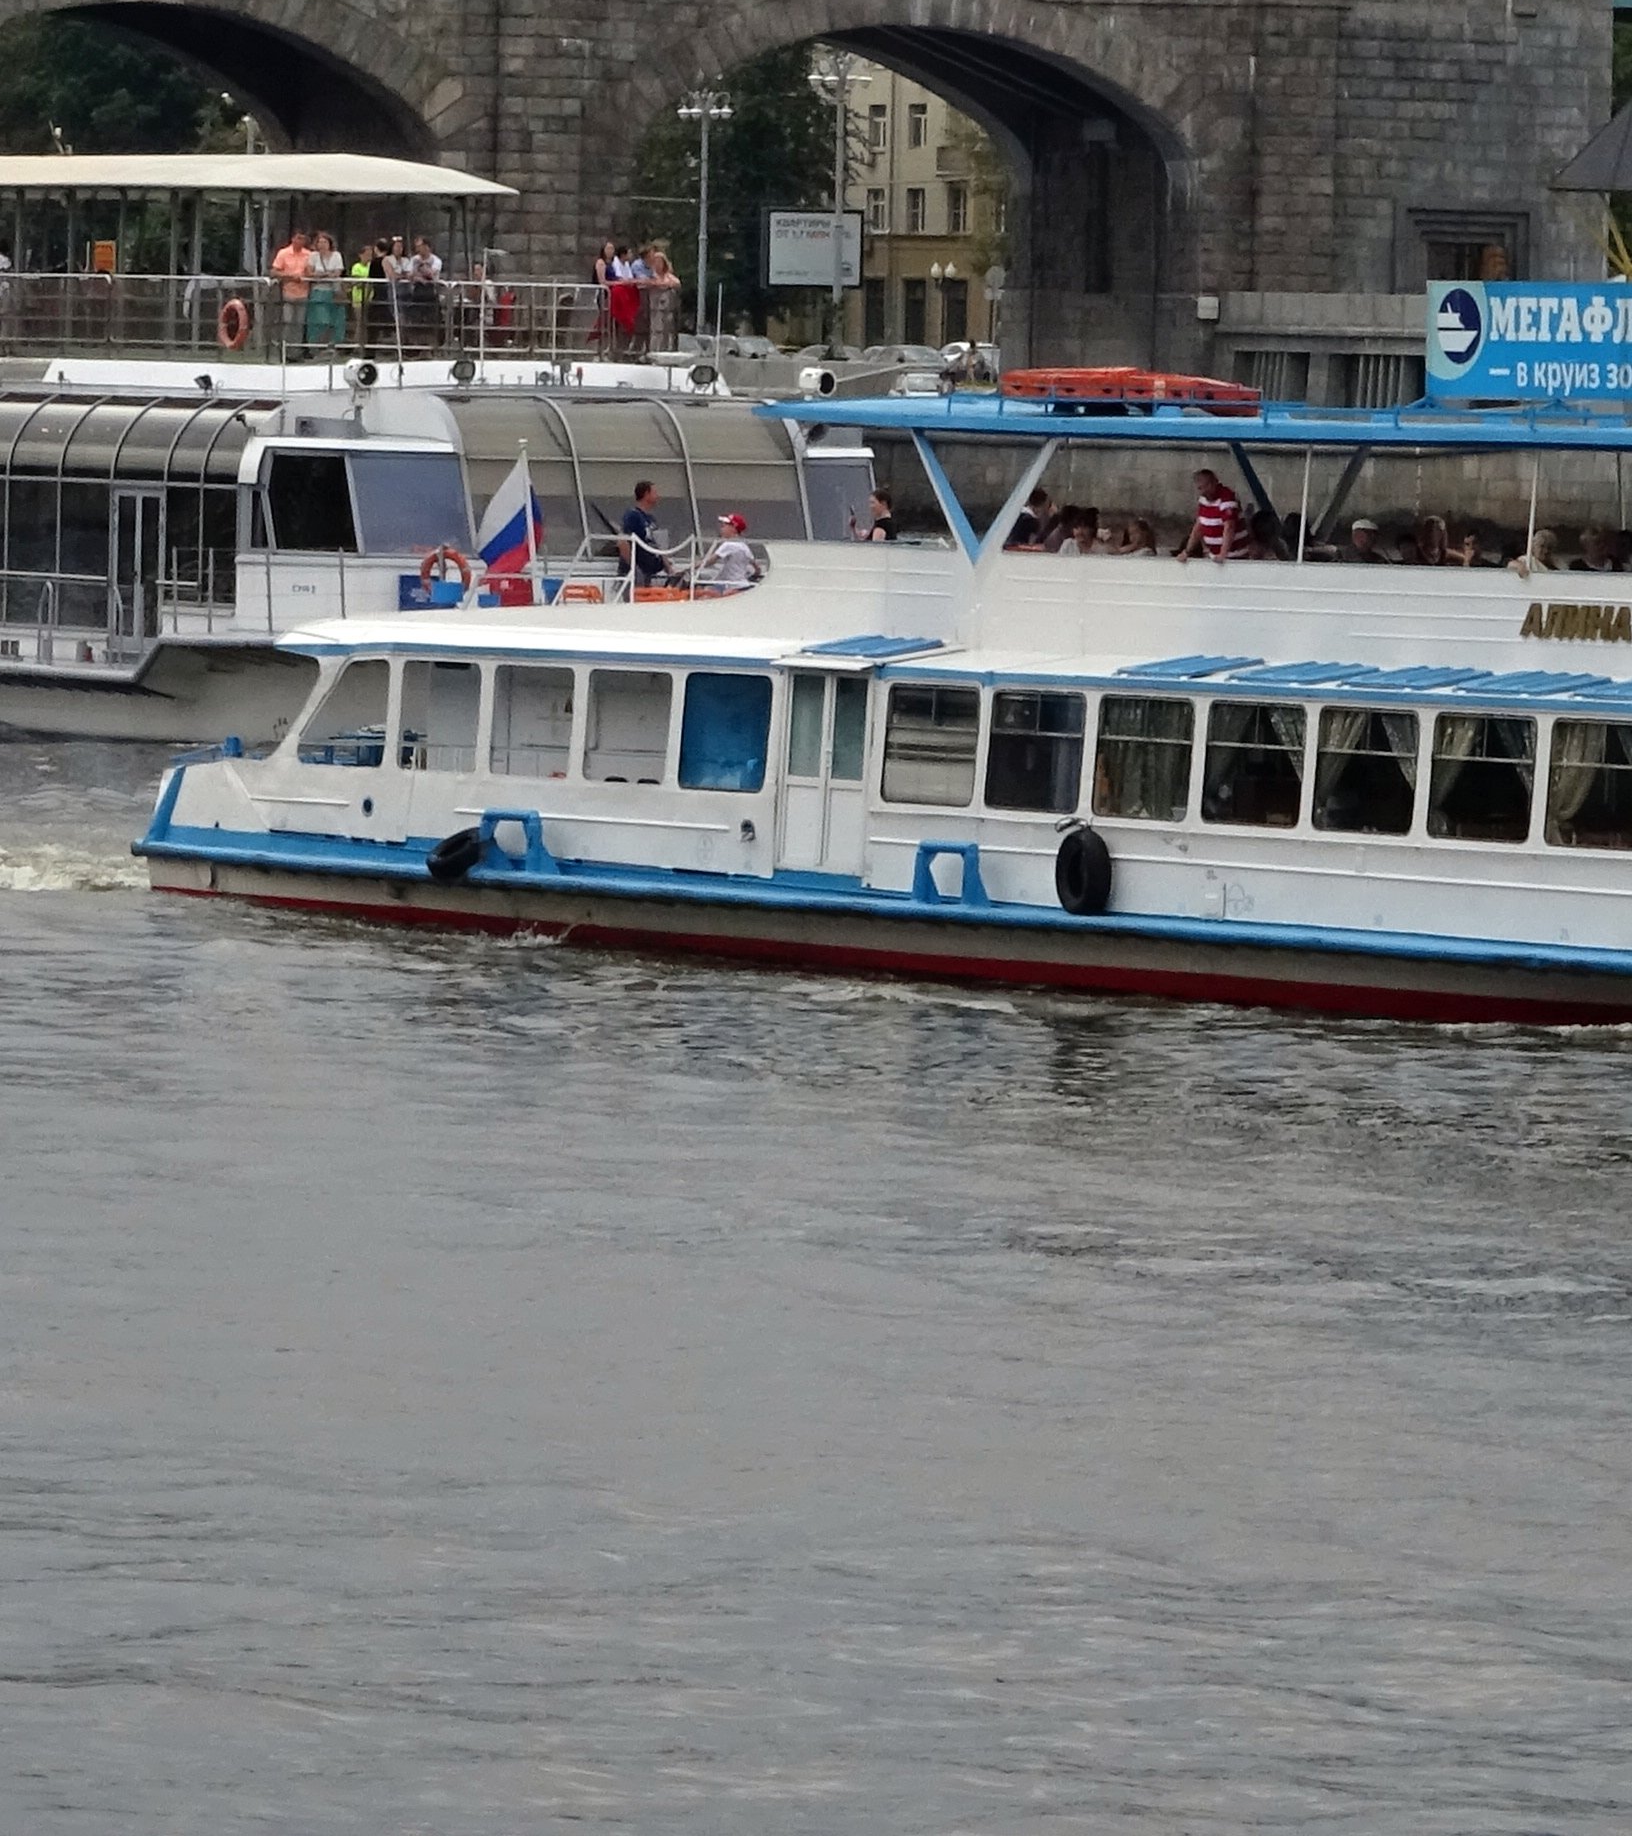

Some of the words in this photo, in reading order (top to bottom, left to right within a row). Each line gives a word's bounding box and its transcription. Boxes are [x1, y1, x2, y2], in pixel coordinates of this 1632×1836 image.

[1517, 365, 1529, 386] в
[1534, 365, 1601, 395] круиз
[1520, 603, 1632, 644] АЛИНА
